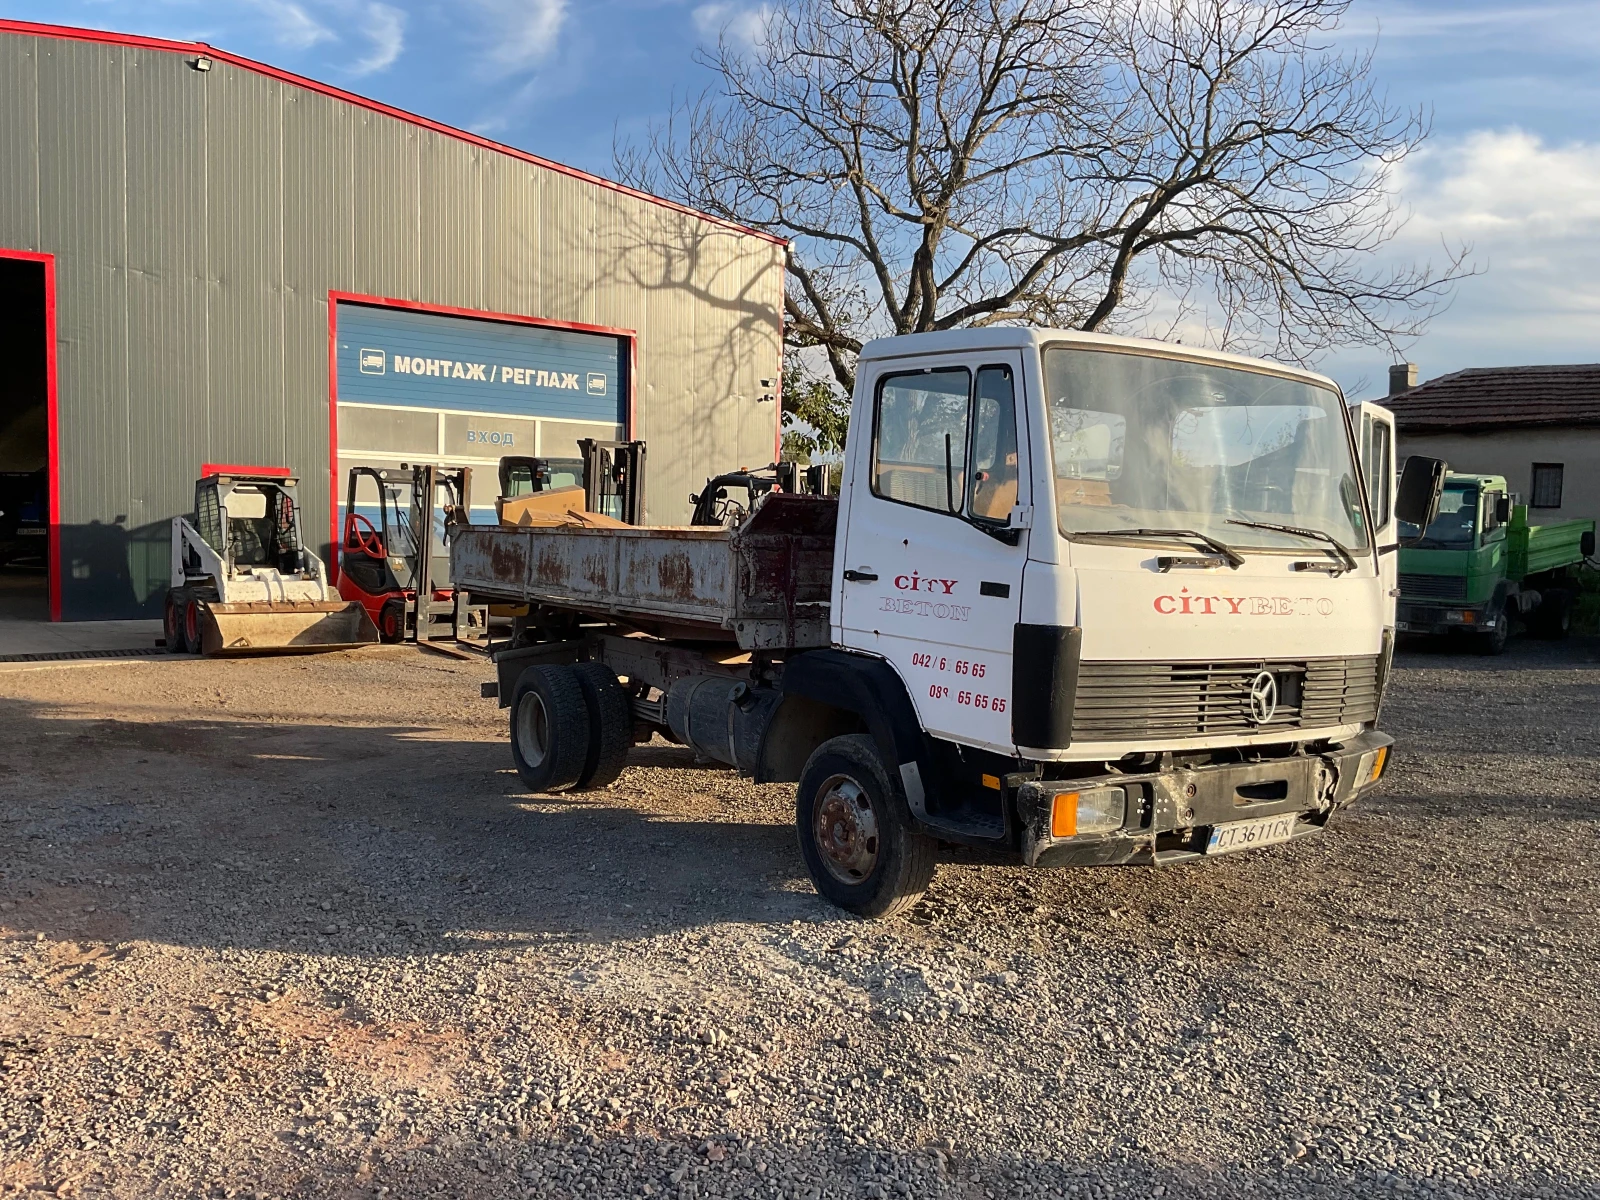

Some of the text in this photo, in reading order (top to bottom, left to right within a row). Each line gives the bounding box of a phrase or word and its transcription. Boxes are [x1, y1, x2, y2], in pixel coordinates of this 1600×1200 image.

[394, 356, 579, 390] МОНТАЖ / РЕГЛАЖ
[466, 430, 514, 447] ВХОД
[879, 597, 971, 621] BETON
[956, 660, 969, 675] 65
[972, 663, 986, 678] 65
[958, 691, 972, 705] 65
[975, 694, 989, 709] 65
[992, 697, 1007, 713] 65
